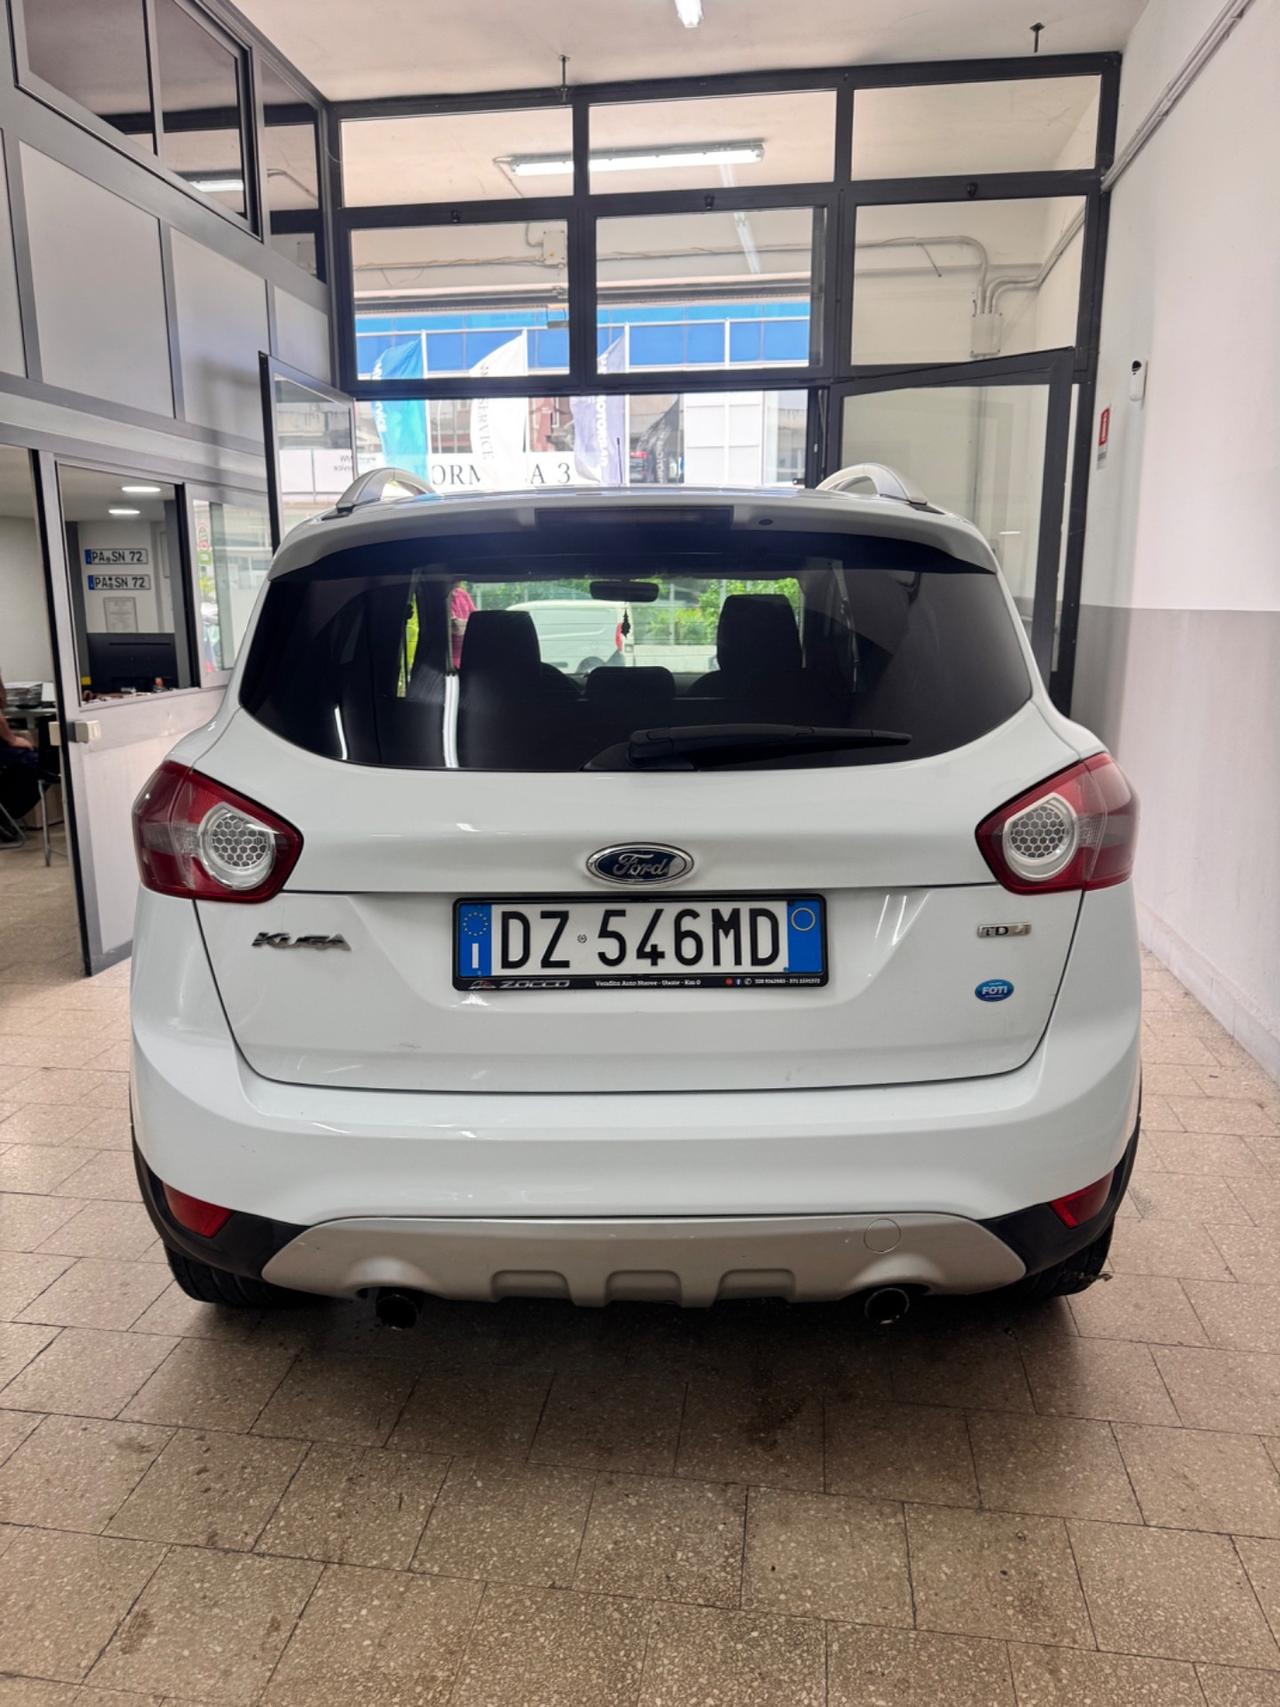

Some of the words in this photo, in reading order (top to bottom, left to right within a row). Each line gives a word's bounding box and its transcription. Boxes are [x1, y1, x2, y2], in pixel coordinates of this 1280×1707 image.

[557, 462, 571, 484] 3
[92, 551, 105, 562] PA
[111, 551, 126, 562] SN
[129, 551, 143, 562] 72
[95, 577, 108, 588] PA
[114, 577, 128, 588] SN
[131, 577, 146, 588] 72
[612, 853, 669, 876] Ford
[501, 910, 571, 969] DZ
[597, 907, 780, 967] 546MD
[981, 985, 1008, 995] FOTI
